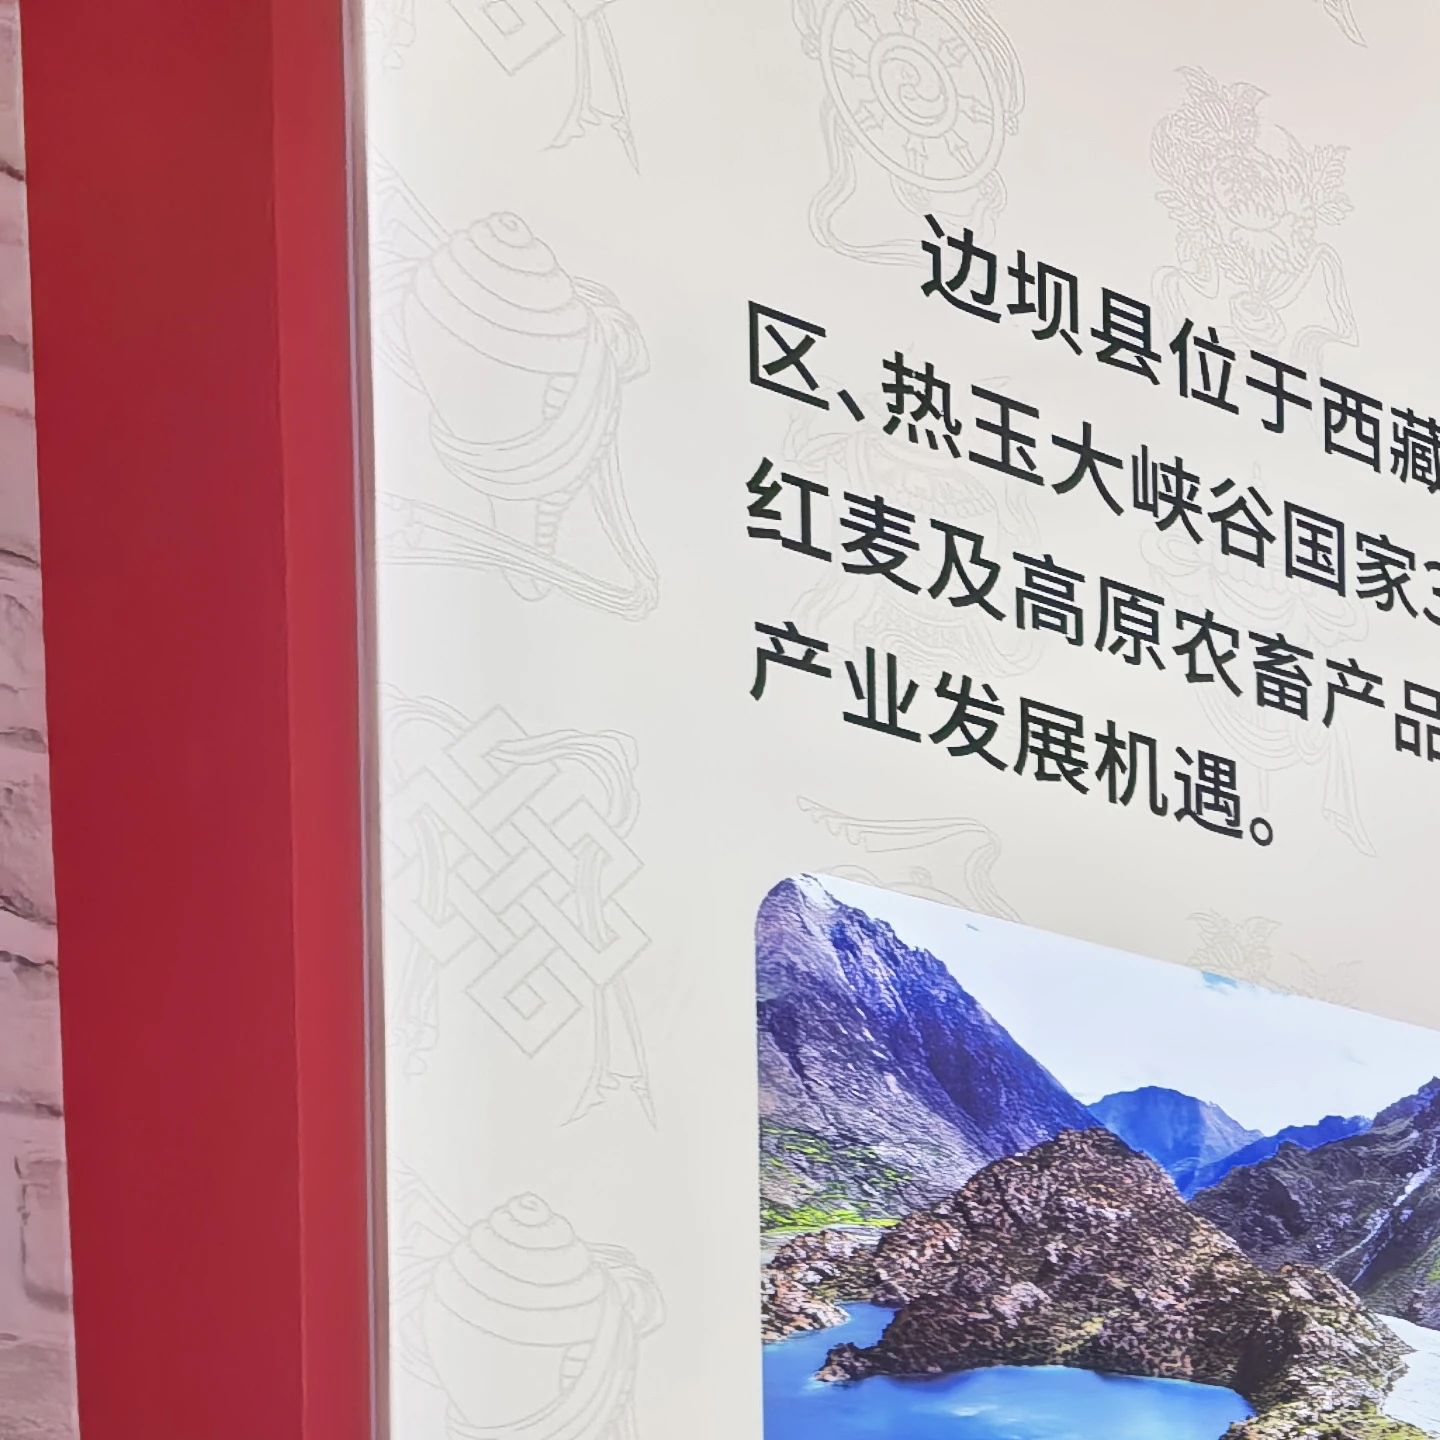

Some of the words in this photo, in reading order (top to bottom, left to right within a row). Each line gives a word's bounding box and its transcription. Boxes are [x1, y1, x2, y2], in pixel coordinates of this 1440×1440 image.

[748, 619, 1275, 848] 产业发展机遇。
